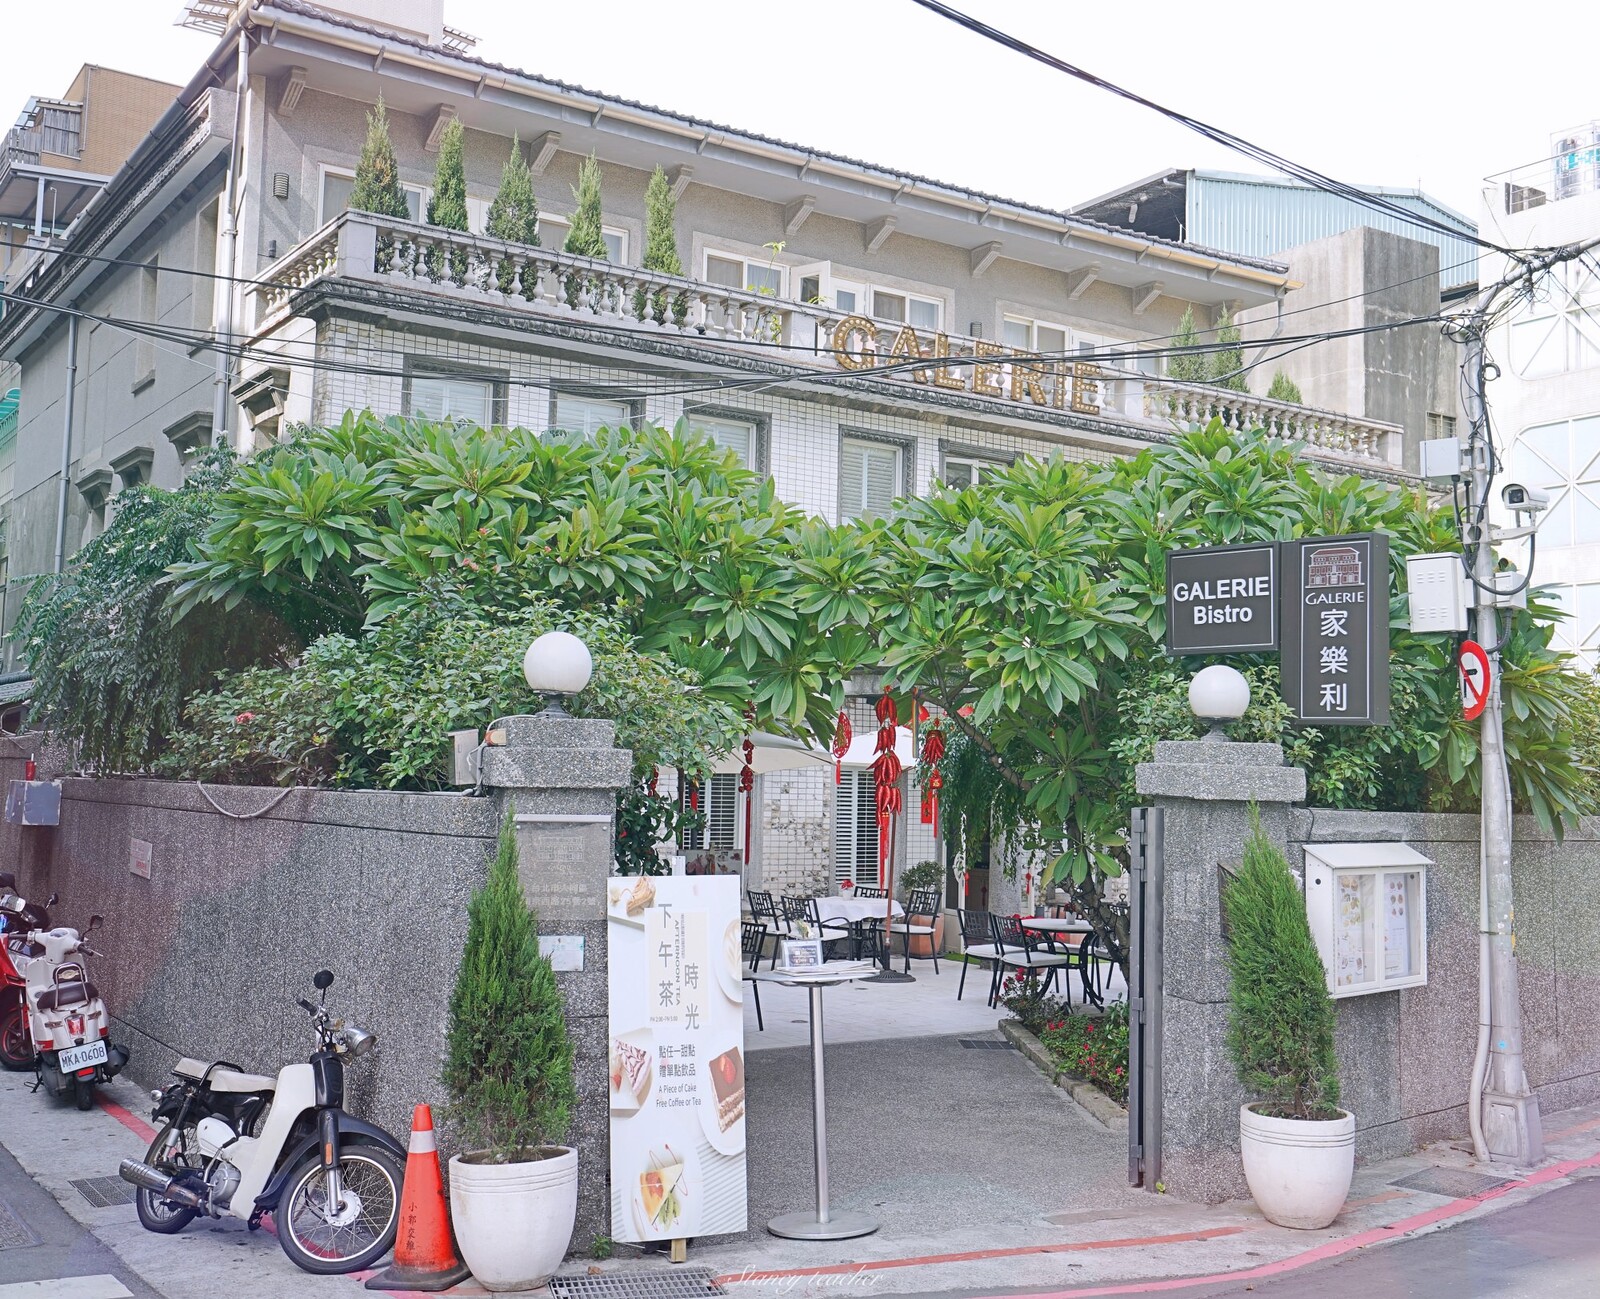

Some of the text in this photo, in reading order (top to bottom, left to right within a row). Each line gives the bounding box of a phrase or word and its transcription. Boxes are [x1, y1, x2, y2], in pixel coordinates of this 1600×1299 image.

[832, 314, 1103, 415] GALERIE
[1173, 577, 1270, 602] GALERIE
[1305, 591, 1365, 605] GALERIE
[1193, 604, 1253, 625] Bistro
[1319, 609, 1348, 712] 家樂利
[658, 903, 674, 1008] 下午茶
[684, 962, 700, 1031] 時光
[658, 1083, 697, 1094] A Piece of Cake
[656, 1097, 702, 1108] Free Coffee or Tea
